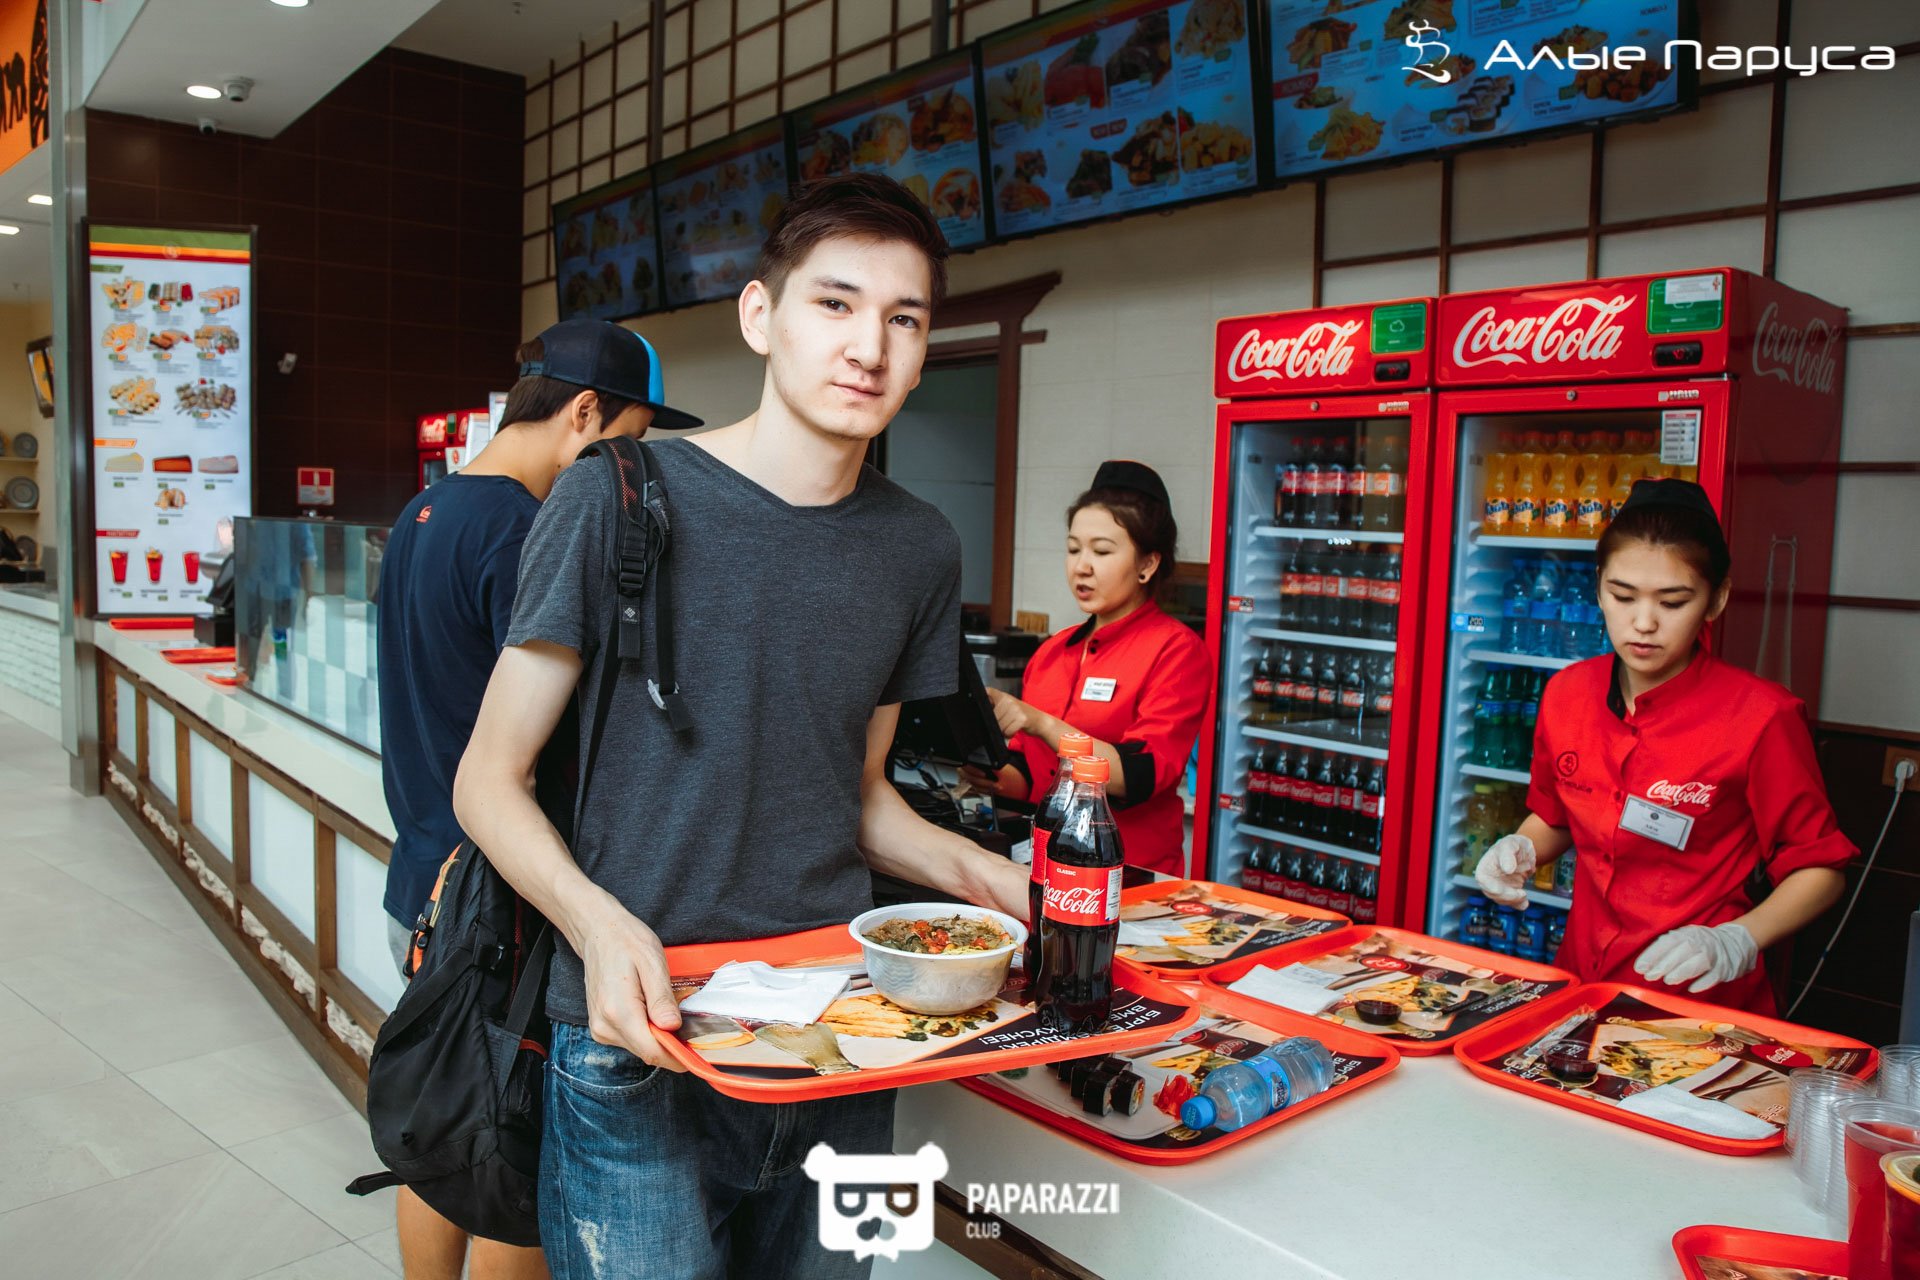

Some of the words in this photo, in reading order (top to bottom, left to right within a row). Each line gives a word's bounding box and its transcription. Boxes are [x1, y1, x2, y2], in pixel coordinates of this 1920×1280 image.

[1227, 319, 1364, 384] Coca-Cola
[1452, 293, 1638, 368] Coca-Cola
[1752, 301, 1843, 395] Coca-Cola
[1646, 779, 1718, 808] Coca-Cola
[1056, 867, 1077, 877] CLASSIC
